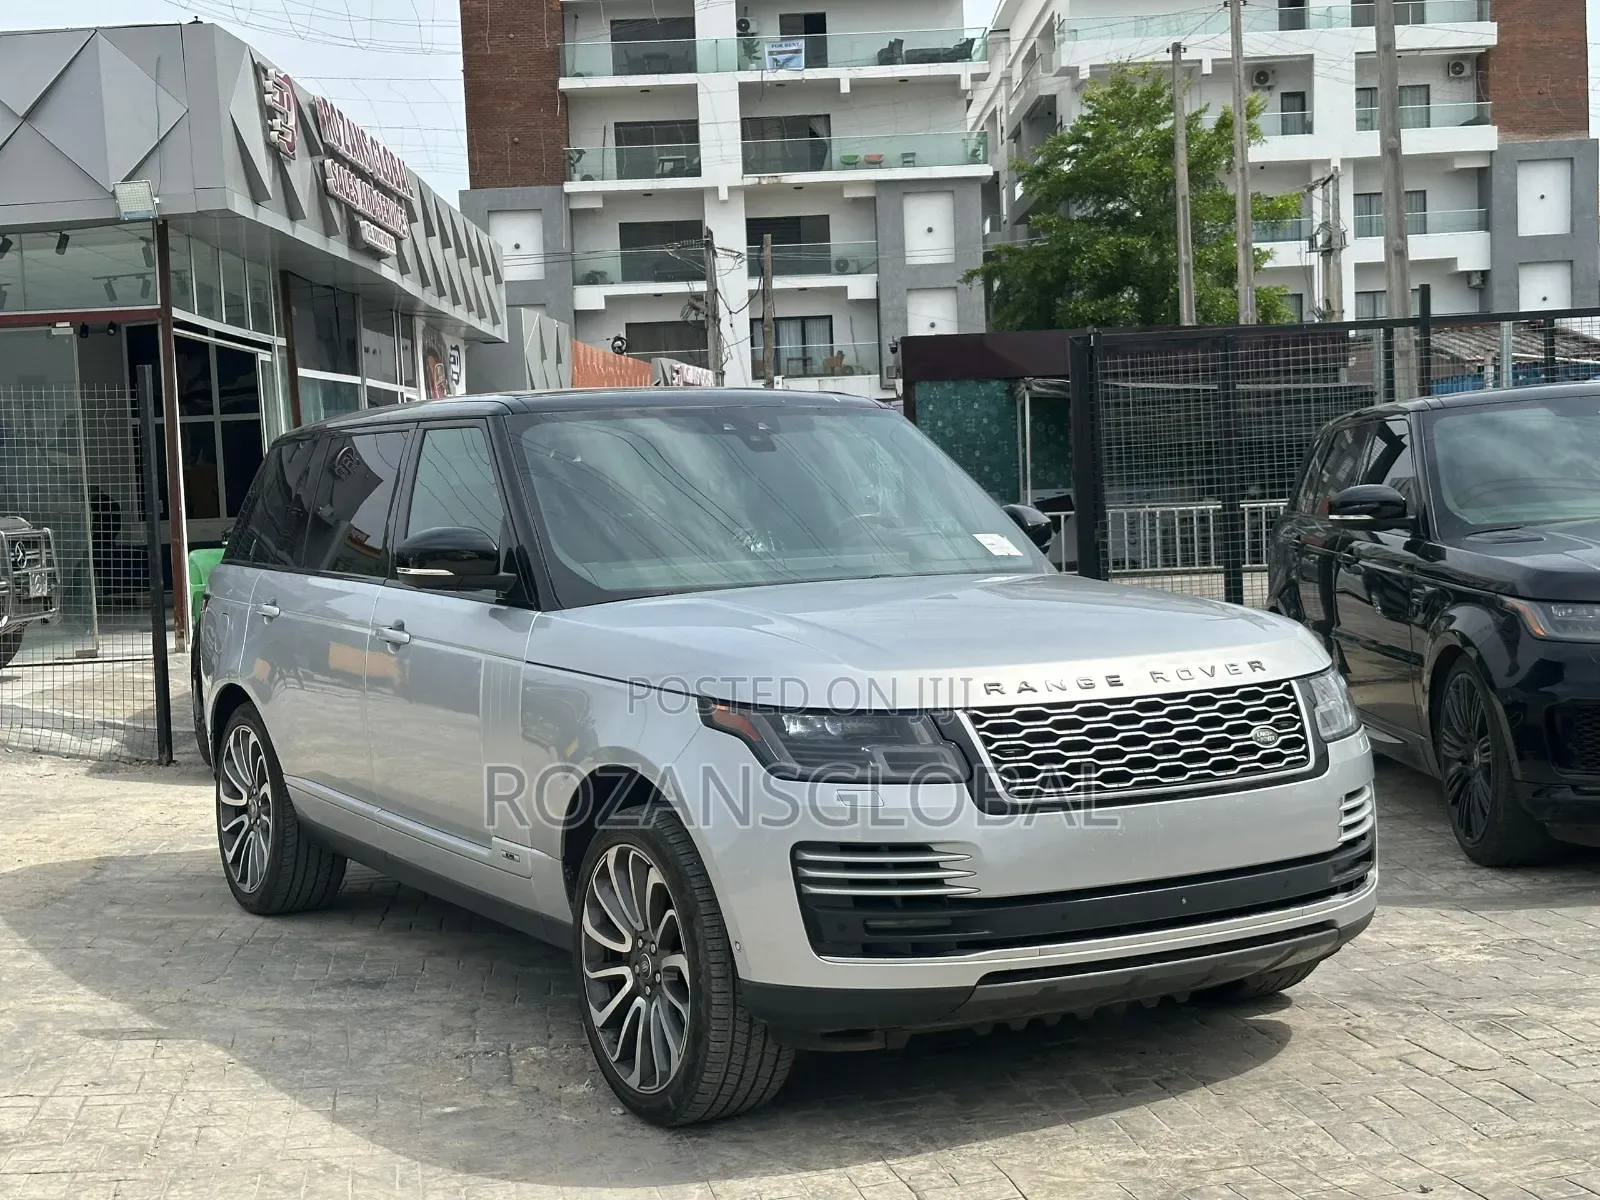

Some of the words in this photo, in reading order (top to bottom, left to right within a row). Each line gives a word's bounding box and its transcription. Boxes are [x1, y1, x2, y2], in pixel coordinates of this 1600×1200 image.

[317, 95, 372, 172] ROZANS
[369, 135, 415, 200] GLOBAL
[327, 158, 360, 209] SALES
[983, 674, 1125, 696] RANGE
[1148, 659, 1267, 683] ROVER
